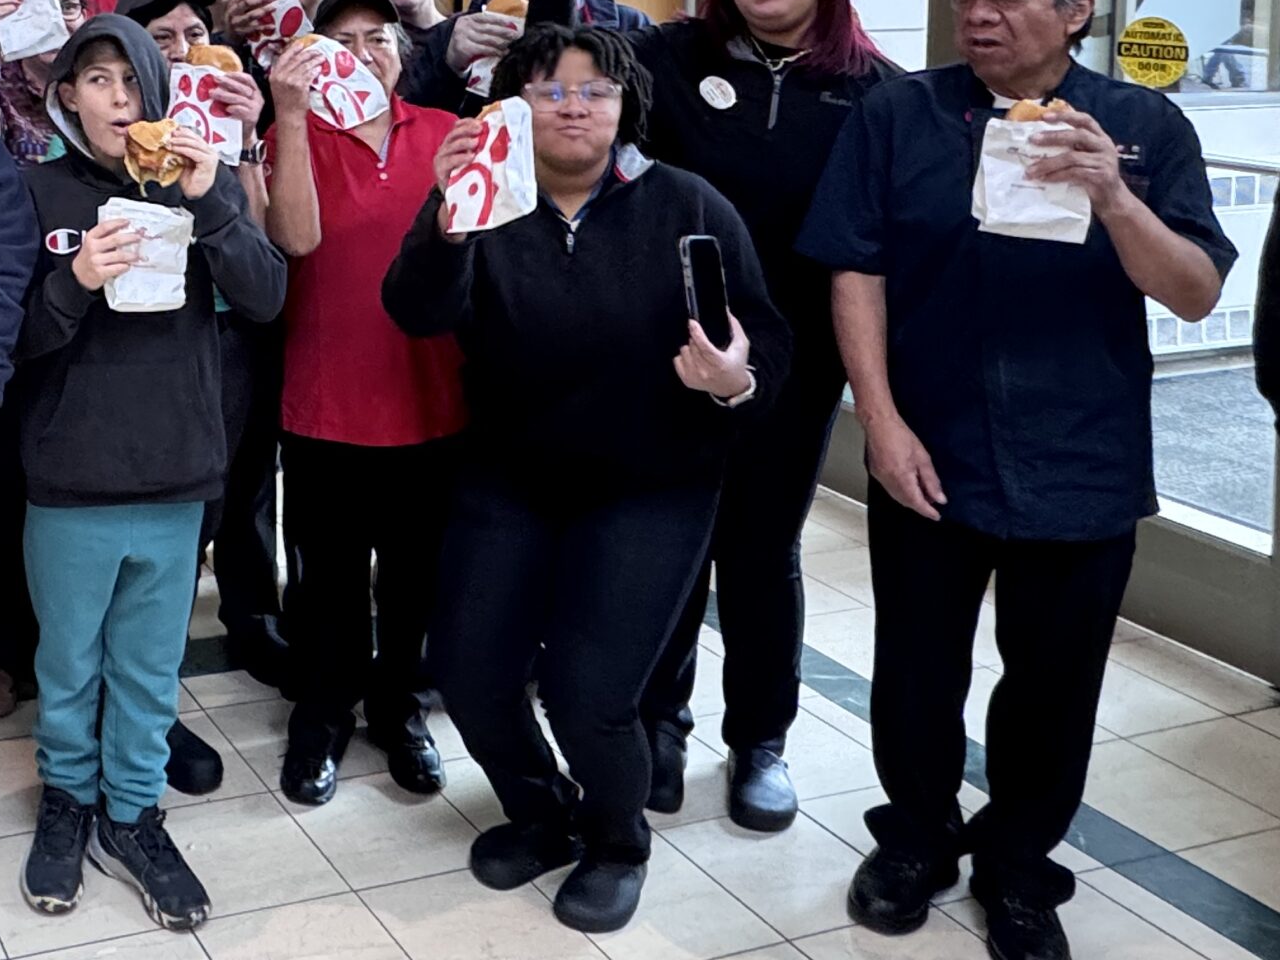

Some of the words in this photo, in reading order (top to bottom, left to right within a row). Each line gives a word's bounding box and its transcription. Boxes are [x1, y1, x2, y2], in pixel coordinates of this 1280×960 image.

[1123, 30, 1185, 43] AUTOMATIC
[1120, 43, 1186, 59] CAUTION
[1137, 61, 1167, 72] DOOR
